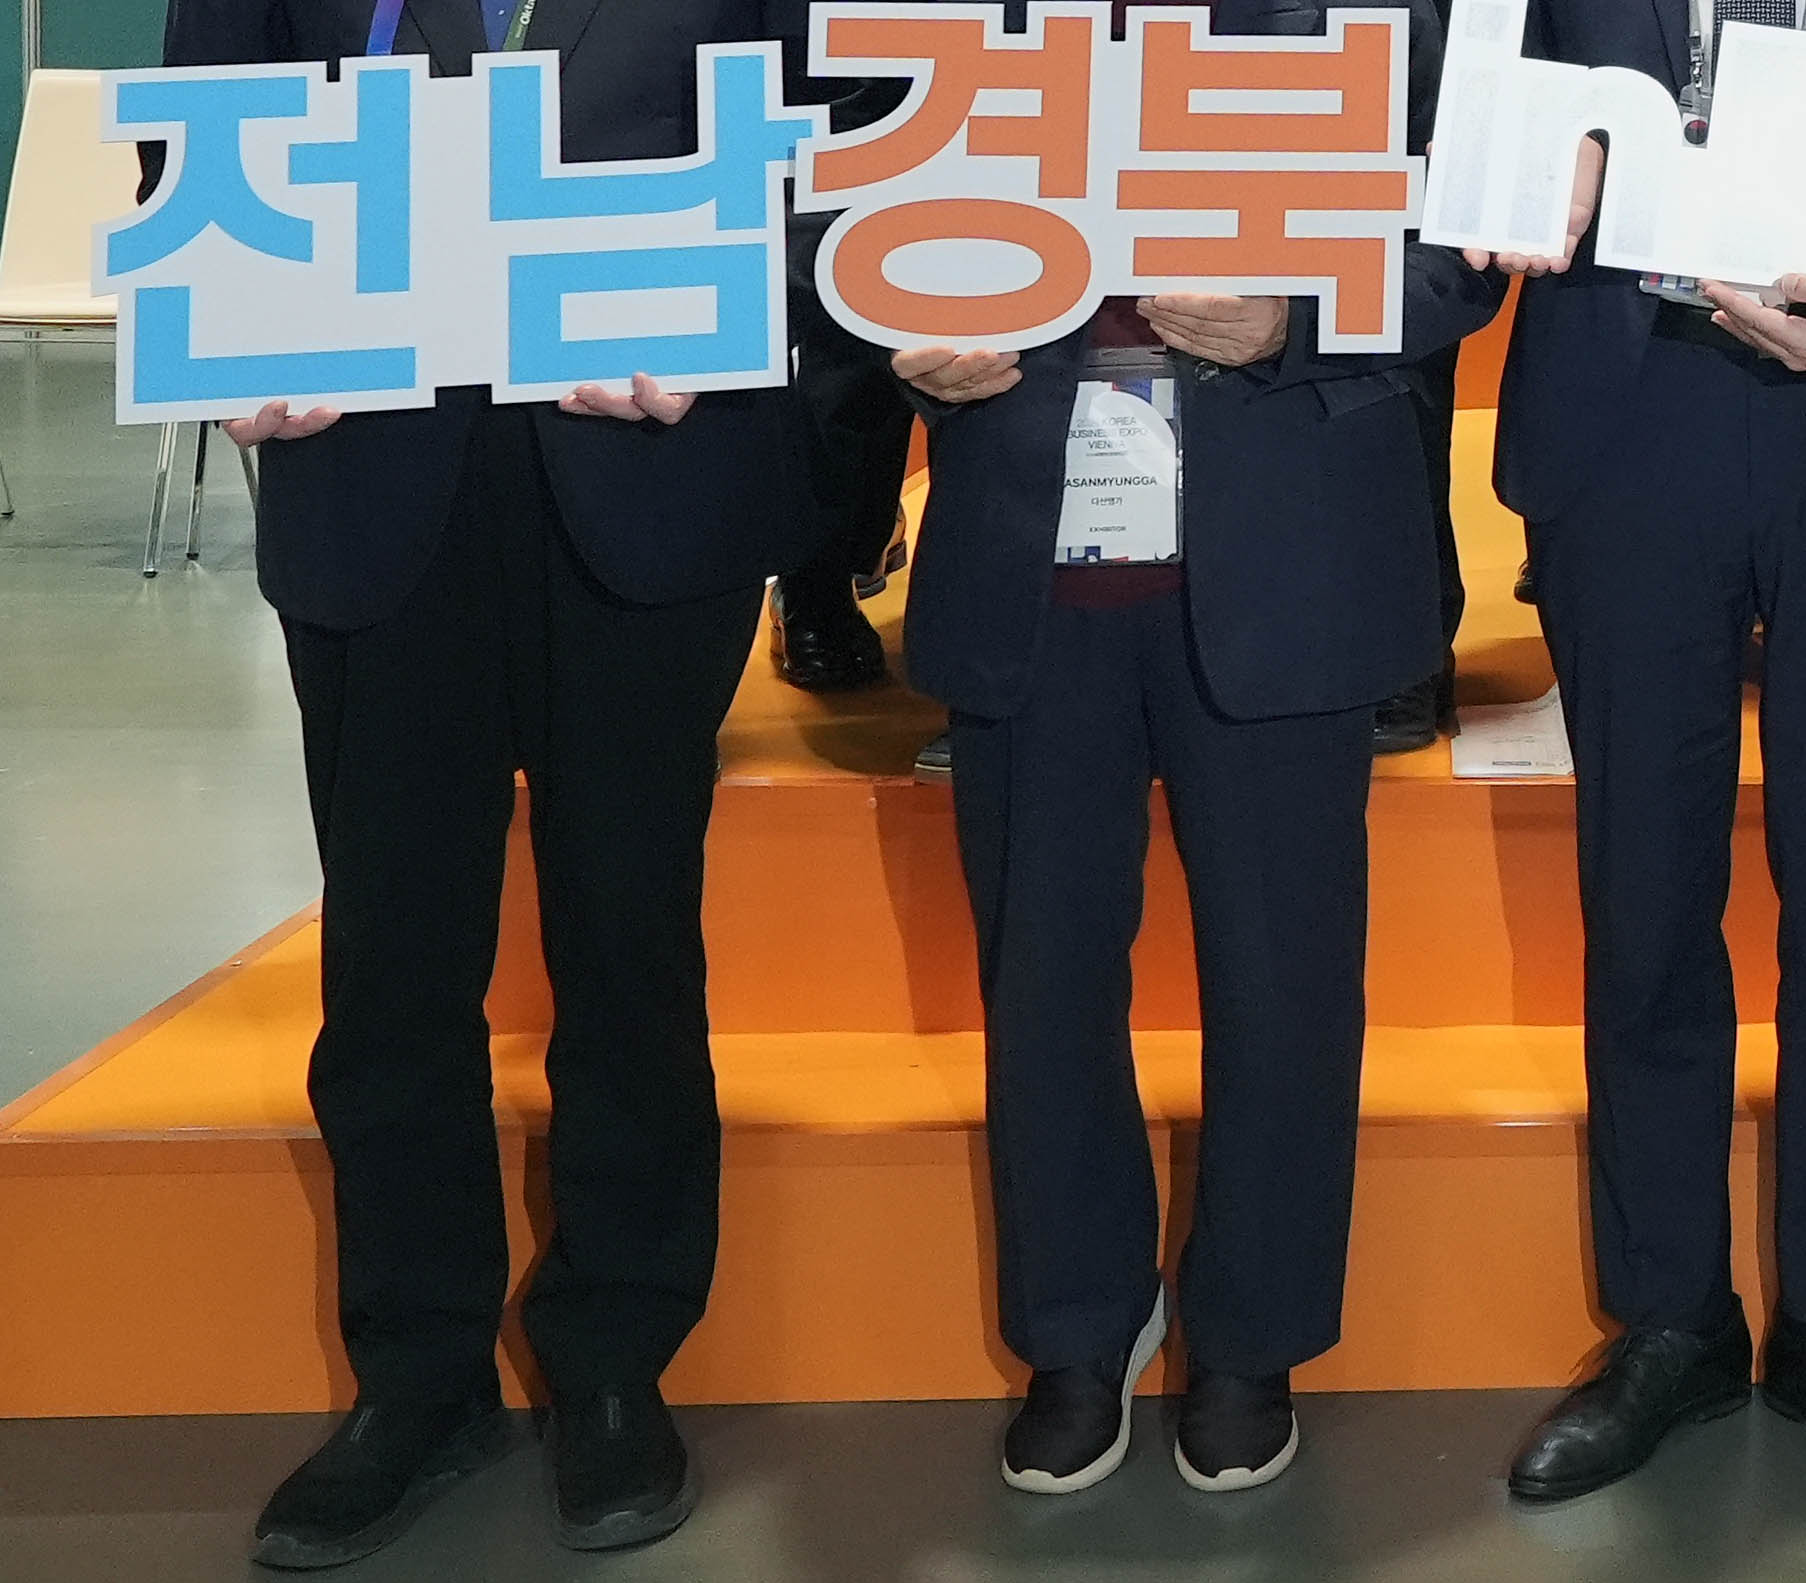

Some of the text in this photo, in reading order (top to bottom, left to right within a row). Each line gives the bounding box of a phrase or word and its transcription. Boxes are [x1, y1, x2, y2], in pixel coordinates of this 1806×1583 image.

[107, 54, 813, 403] 전남
[811, 14, 1408, 335] 경북
[1088, 440, 1126, 449] VIENA
